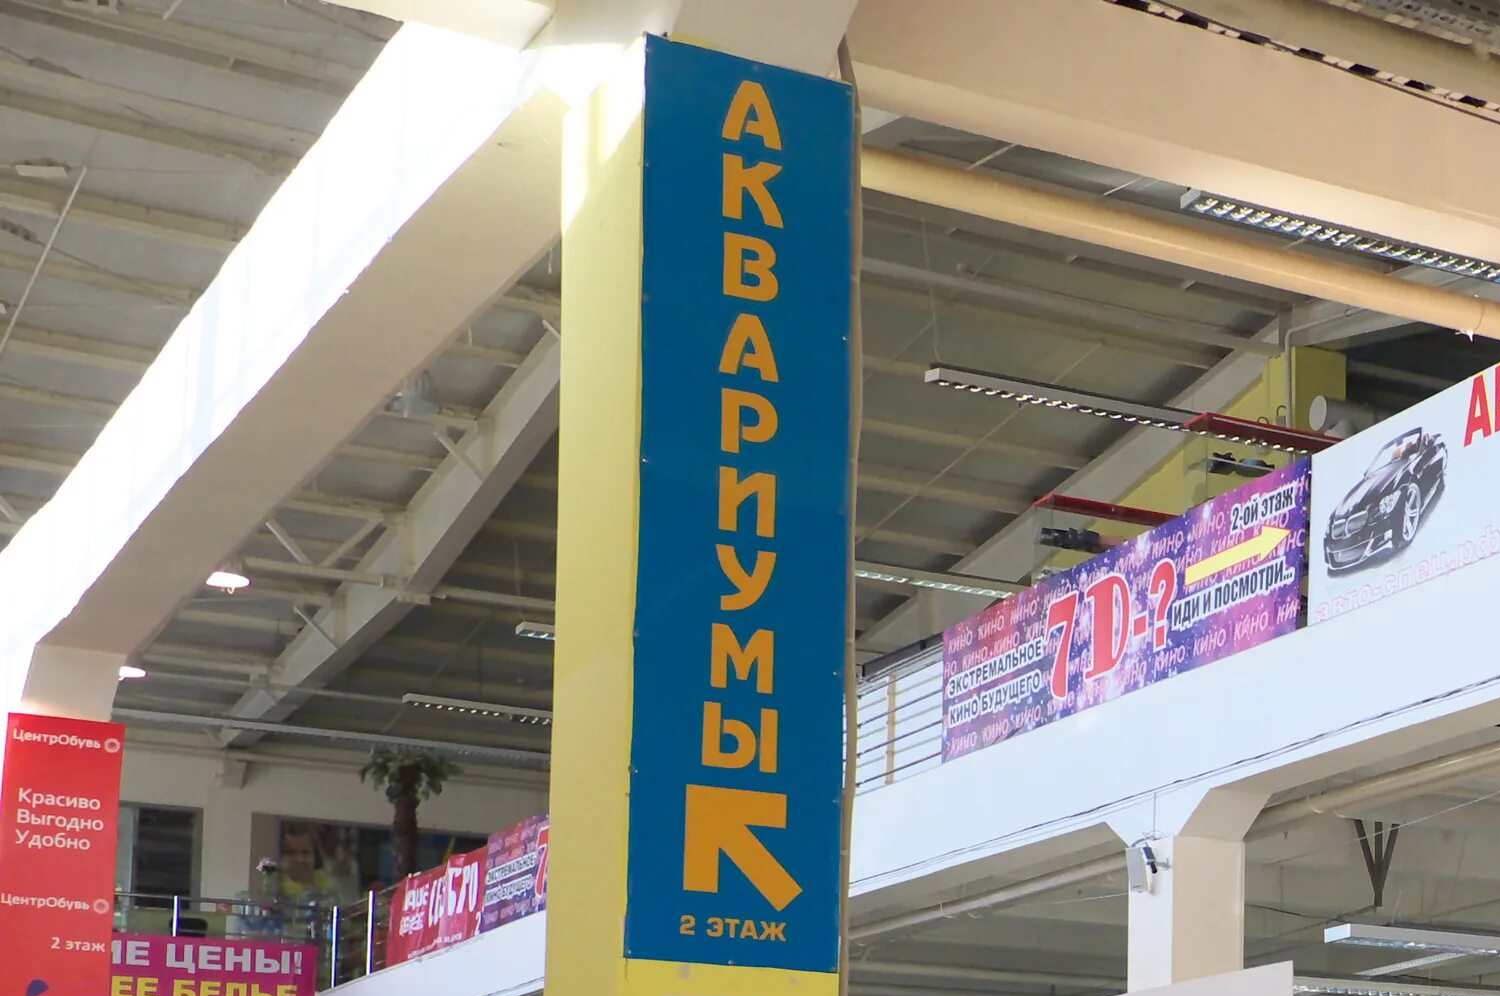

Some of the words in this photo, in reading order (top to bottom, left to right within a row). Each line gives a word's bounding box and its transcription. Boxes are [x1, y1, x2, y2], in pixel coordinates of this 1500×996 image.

[700, 79, 784, 774] АКВАРИУМЫ
[949, 640, 1042, 696] ЭКСТРЕМАЛЬНОЕ
[949, 700, 978, 725] КИНО
[981, 671, 1041, 712] БУДУЩЕГО
[12, 728, 101, 749] ЦентрОбувь
[18, 788, 101, 811] Красиво
[16, 809, 104, 832] Выгодно
[15, 829, 91, 850] Удобно
[1, 892, 90, 911] ЦентрОбувь
[679, 914, 697, 937] 2
[705, 915, 787, 942] ЭТАЖ
[51, 937, 60, 949] 2
[65, 939, 106, 953] этаж
[166, 943, 303, 975] ЦЕНЫ!
